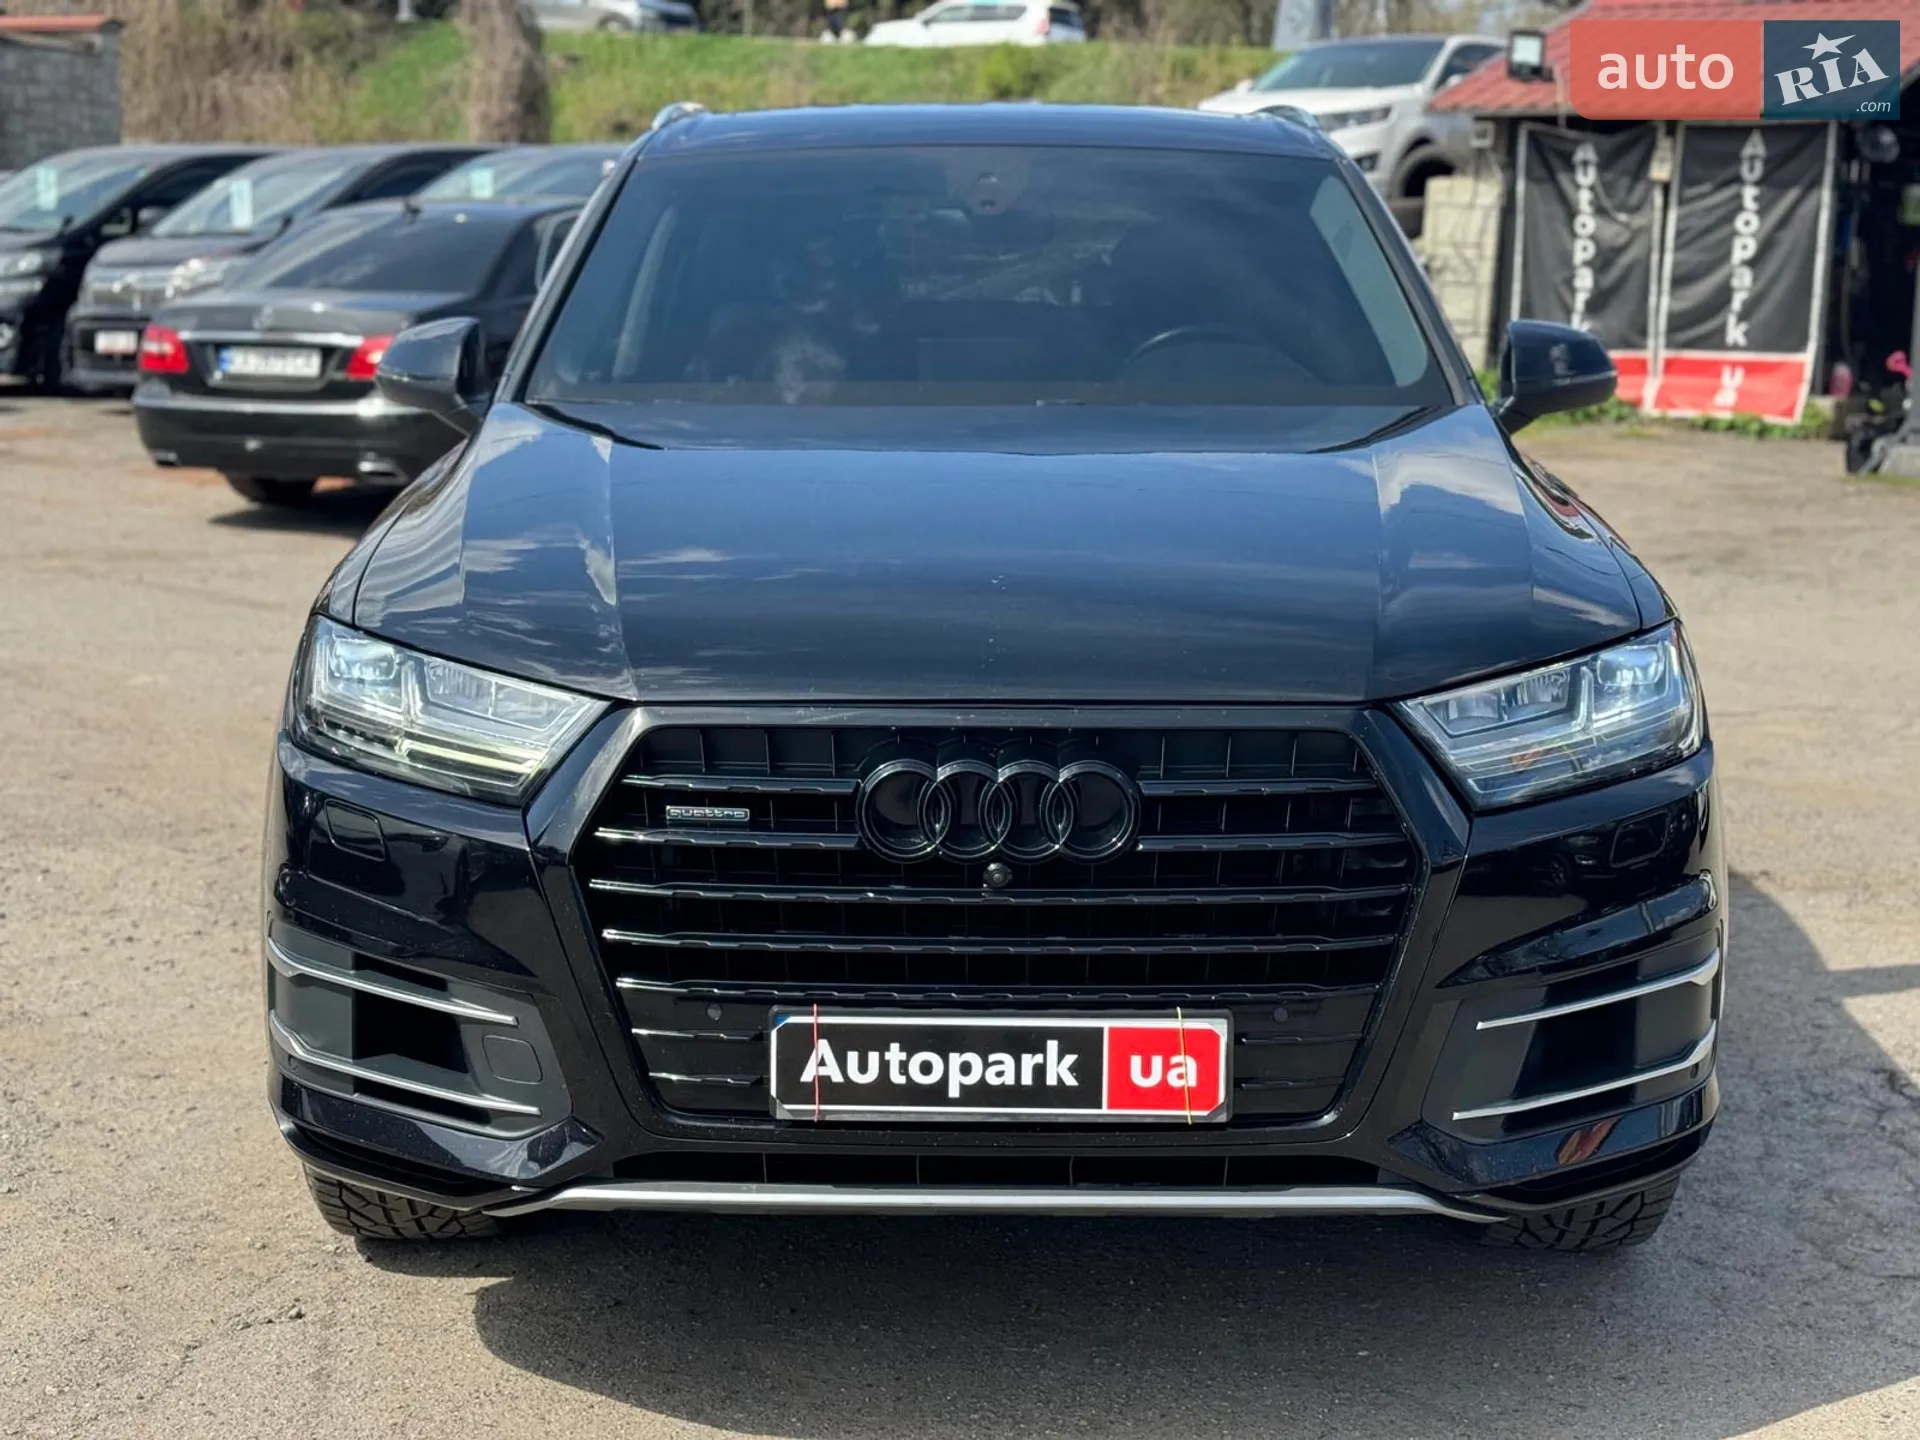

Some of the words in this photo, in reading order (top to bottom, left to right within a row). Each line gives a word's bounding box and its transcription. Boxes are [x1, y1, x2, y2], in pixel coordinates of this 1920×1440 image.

[668, 807, 746, 819] quattro
[800, 1038, 1079, 1098] Autopark
[1129, 1054, 1198, 1088] ua
